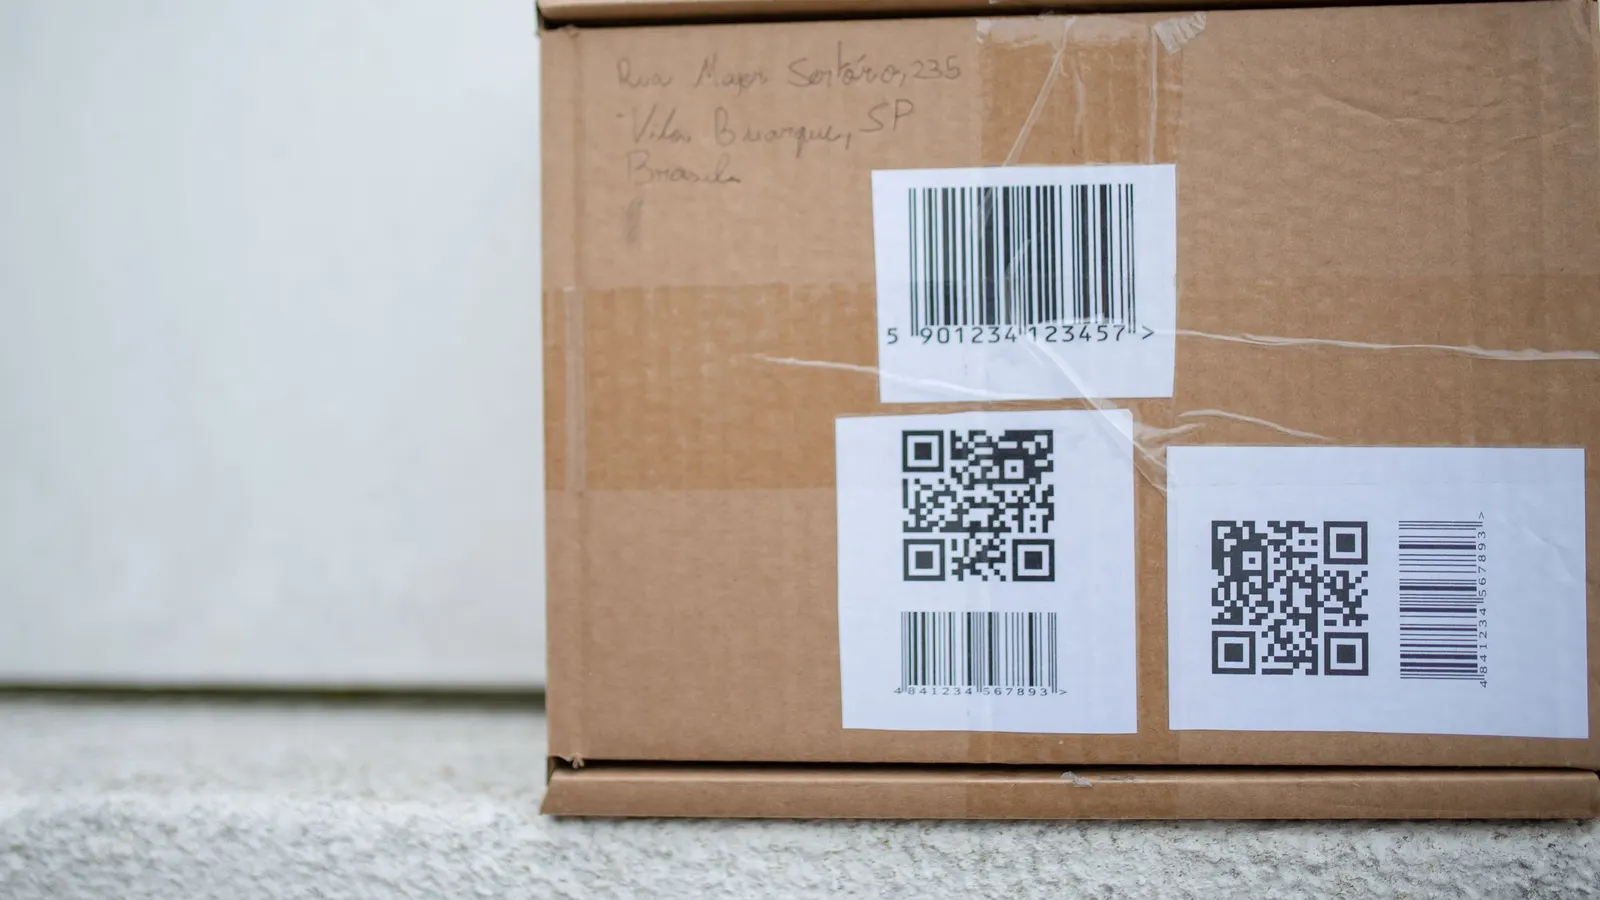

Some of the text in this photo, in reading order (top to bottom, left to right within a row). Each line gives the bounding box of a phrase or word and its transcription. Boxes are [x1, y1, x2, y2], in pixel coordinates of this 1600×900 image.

[616, 55, 673, 89] Rua
[911, 53, 962, 80] 235
[858, 98, 915, 133] SP
[887, 327, 898, 344] 5
[920, 327, 1018, 344] 901234
[1028, 325, 1126, 342] 123457
